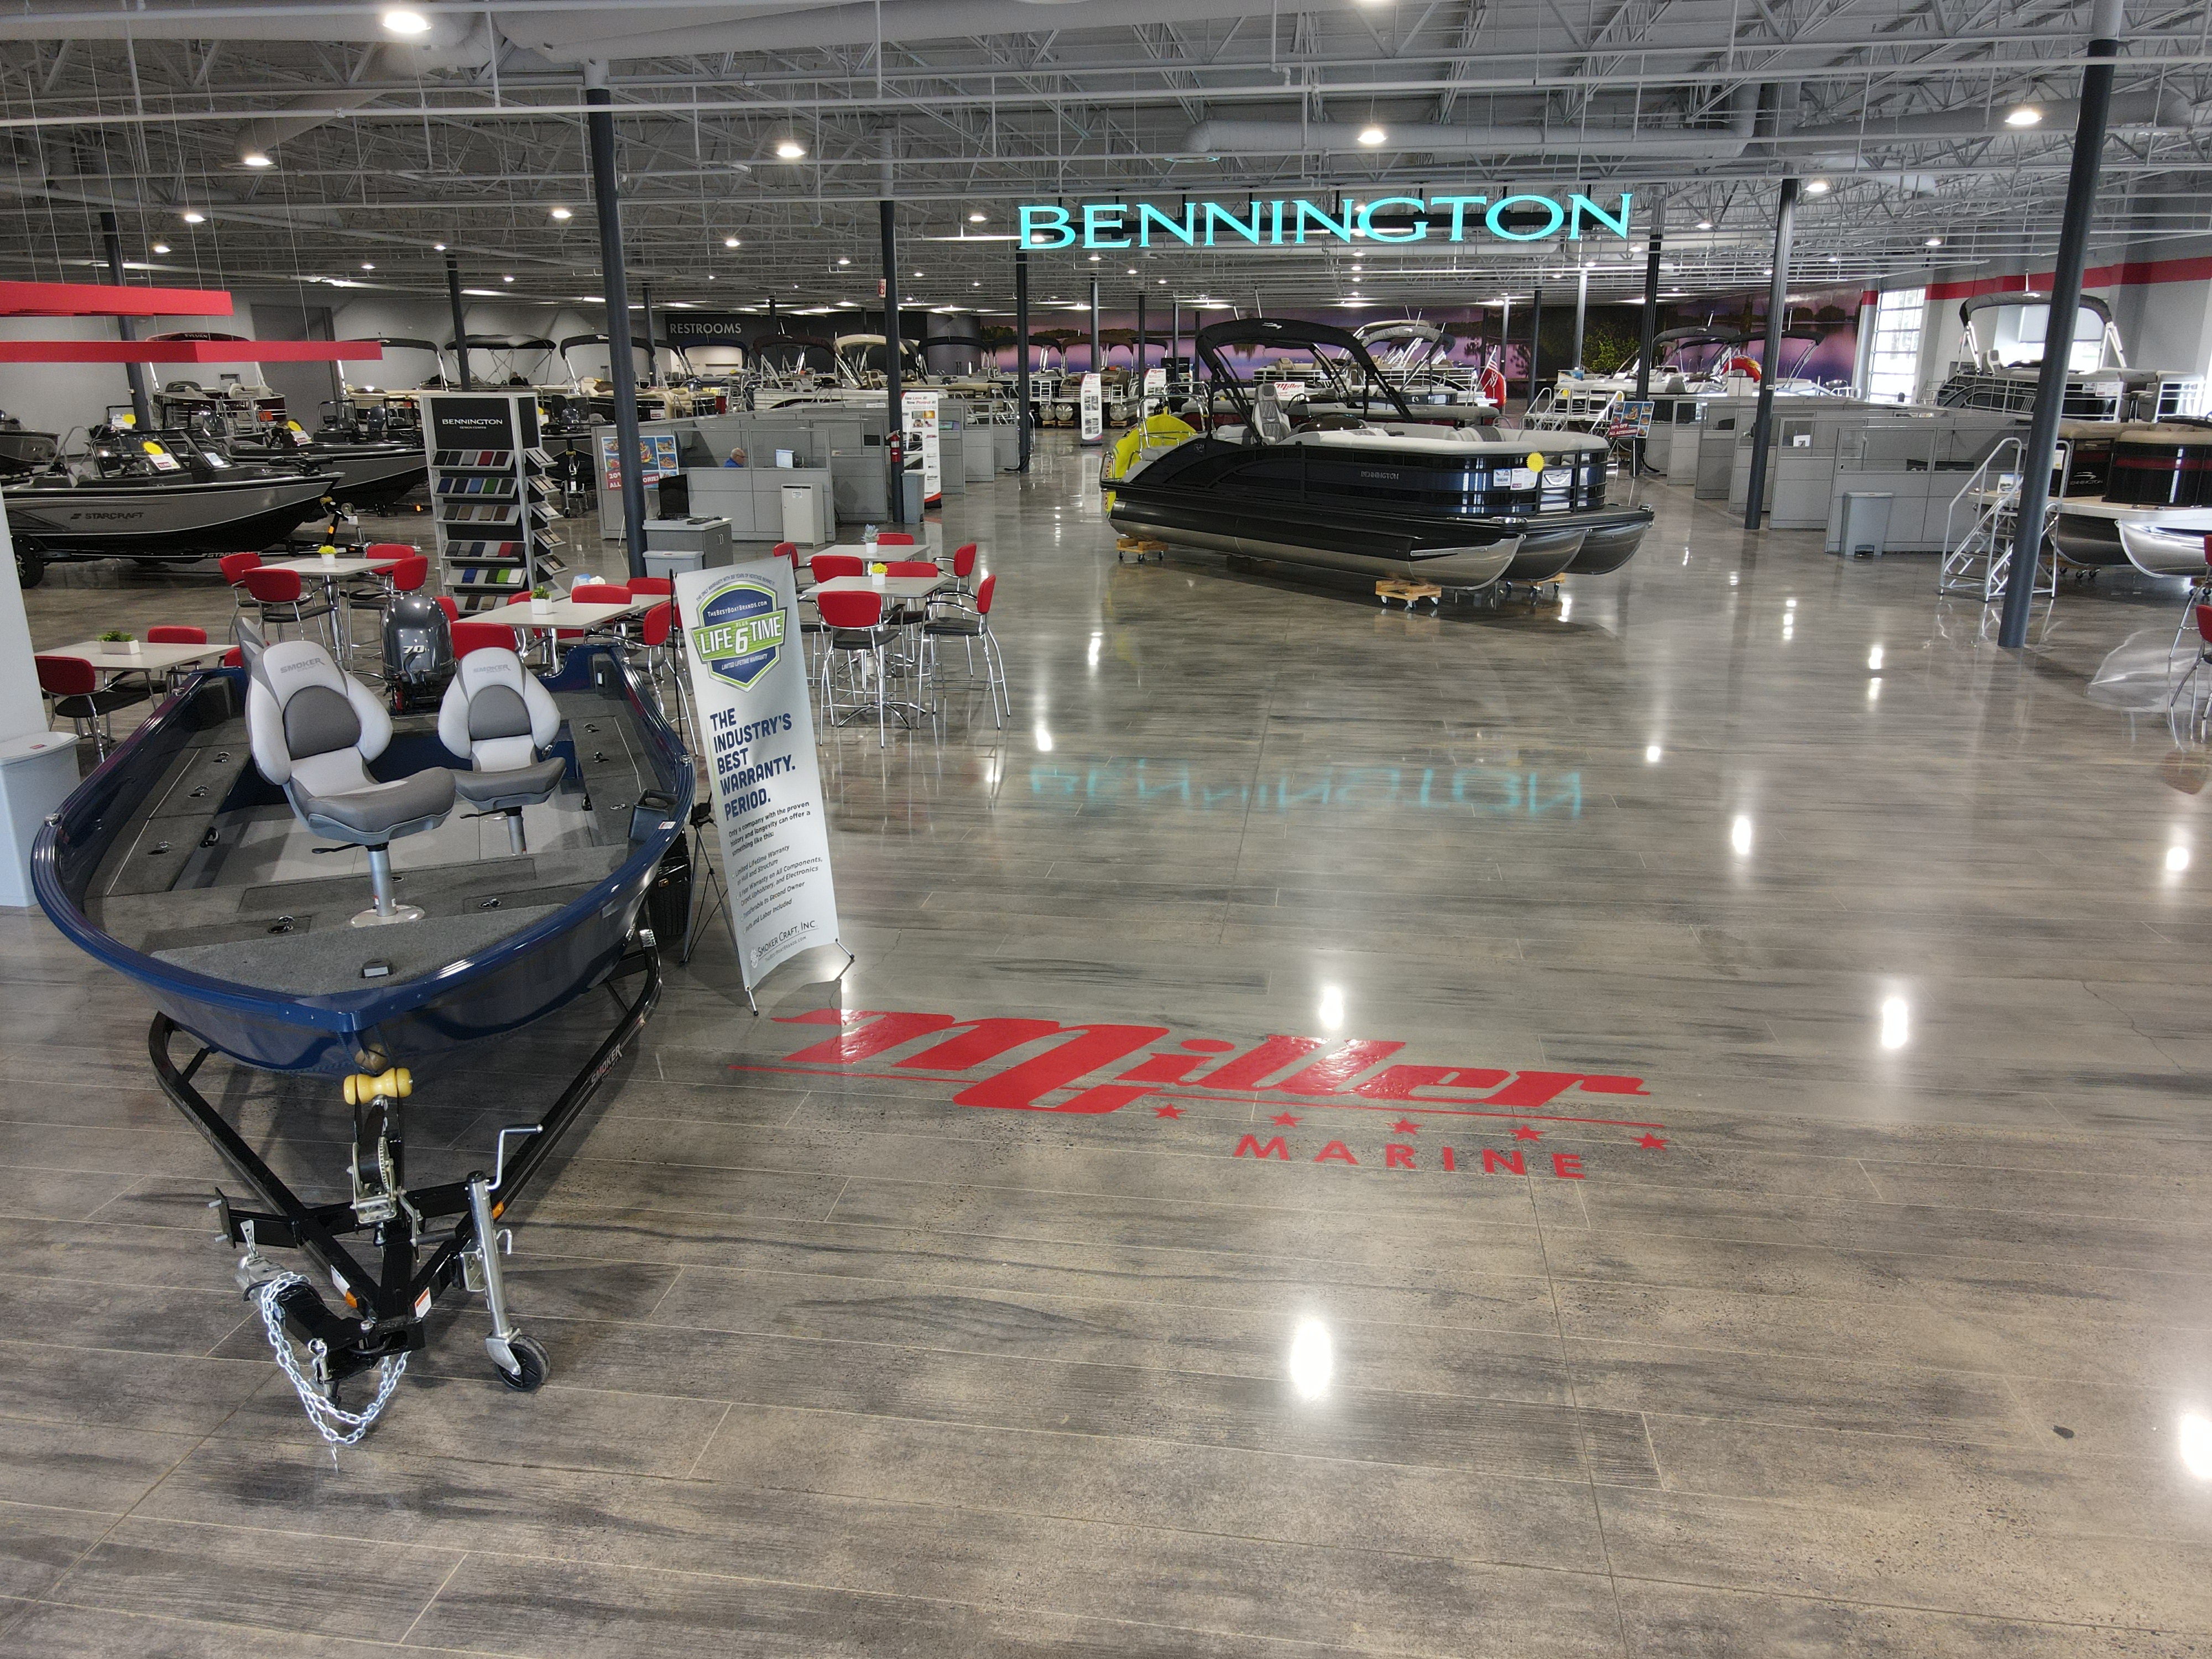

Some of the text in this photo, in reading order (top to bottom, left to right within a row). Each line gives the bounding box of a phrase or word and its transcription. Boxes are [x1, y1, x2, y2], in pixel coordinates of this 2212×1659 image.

[1018, 193, 1633, 249] BENNINGTON
[670, 323, 742, 334] RESTROOMS
[700, 616, 782, 654] LIFE 6 TIME
[403, 645, 425, 654] 70
[280, 658, 325, 674] SMOKER
[710, 707, 737, 731] THE
[713, 713, 792, 753] INDUSTRY'S
[717, 747, 749, 775] BEST
[720, 754, 796, 796] WARRANTY.
[724, 788, 771, 821] PERIOD.
[742, 817, 764, 831] company
[765, 812, 776, 820] with
[787, 802, 810, 813] proven
[745, 830, 753, 839] and
[754, 821, 778, 835] longevity
[790, 812, 804, 820] offer
[754, 836, 763, 844] like
[749, 855, 766, 868] Lifetime
[768, 845, 790, 858] Warranty
[749, 876, 768, 889] Warranty
[783, 857, 823, 872] Components,
[776, 876, 785, 885] and
[786, 866, 818, 880] Electronics
[787, 881, 805, 892] Owner
[760, 909, 772, 921] Labor
[773, 898, 792, 912] Included
[758, 937, 779, 957] SMOKER
[591, 1043, 623, 1088] SMOKER
[771, 1008, 1651, 1115] Miller
[1234, 1134, 1586, 1181] MARINE
